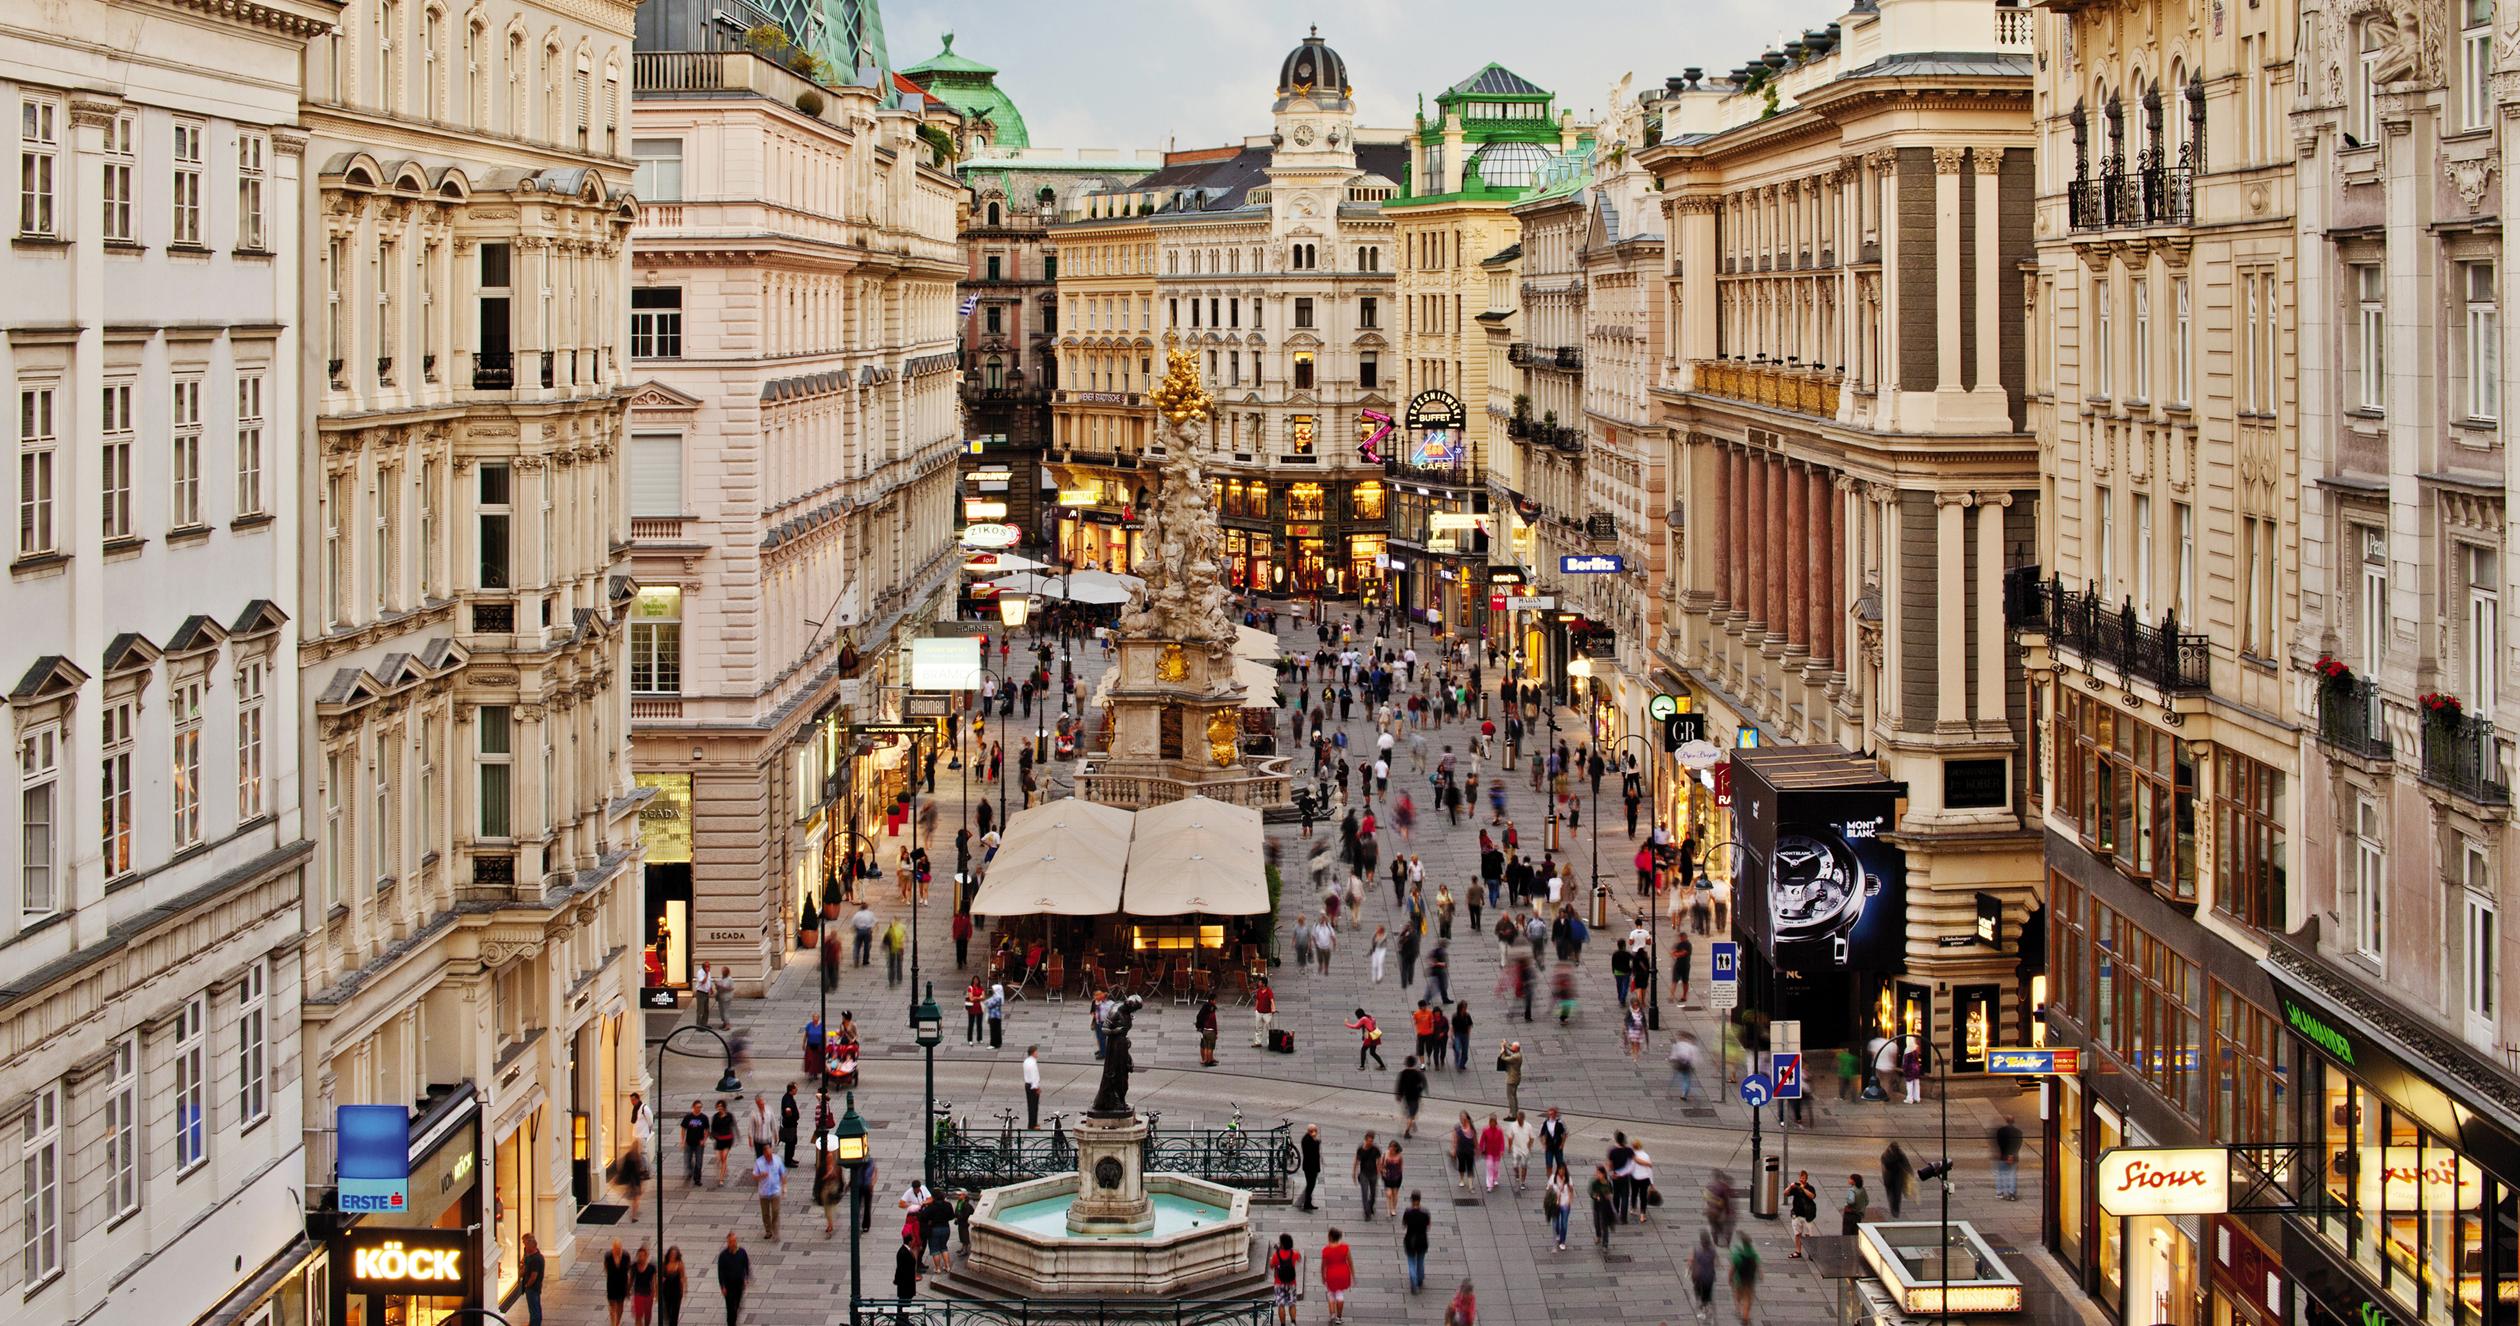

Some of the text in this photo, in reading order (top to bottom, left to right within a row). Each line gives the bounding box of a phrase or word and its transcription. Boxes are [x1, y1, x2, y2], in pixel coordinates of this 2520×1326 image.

[1409, 391, 1462, 421] TRZESNIEWSKI
[1419, 414, 1451, 422] BUFFET
[971, 526, 1008, 537] ZIKOS
[1566, 557, 1616, 571] Berlitz
[1672, 720, 1696, 741] GR
[1743, 729, 1754, 749] K
[1846, 820, 1876, 829] MONT
[1846, 829, 1876, 838] BLANC
[711, 932, 745, 940] ESCADA
[2285, 999, 2356, 1067] SALAMANDER
[2006, 1056, 2046, 1069] Tchibo
[440, 1150, 473, 1195] VON KÖCK
[2116, 1160, 2207, 1192] Sioux
[341, 1194, 389, 1210] ERSTE
[354, 1241, 462, 1281] KÖCK
